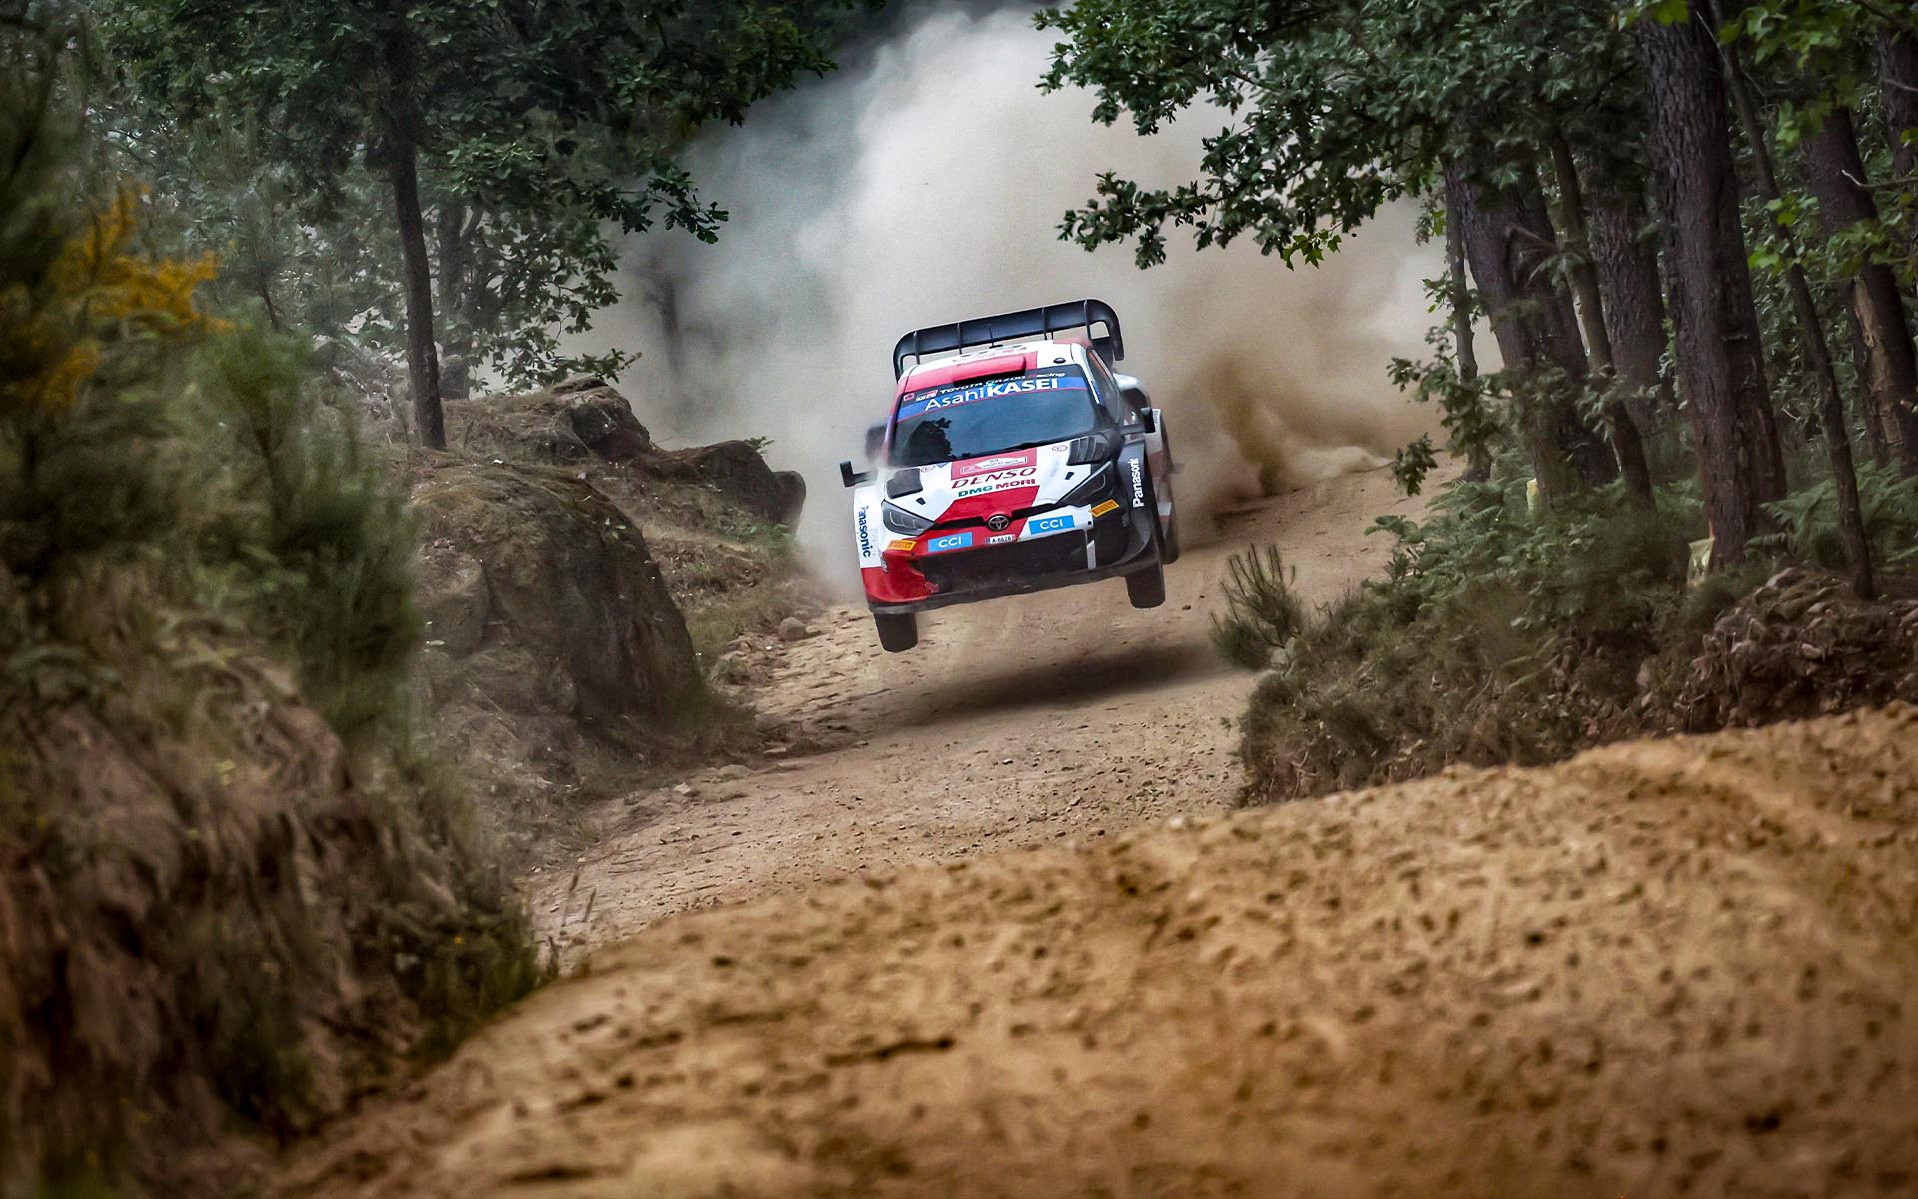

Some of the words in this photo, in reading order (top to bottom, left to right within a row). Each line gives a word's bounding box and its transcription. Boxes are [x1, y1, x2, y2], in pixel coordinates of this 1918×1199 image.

[940, 382, 983, 394] TOYOTA
[952, 468, 1037, 489] DENSO
[958, 485, 993, 497] DMG
[995, 479, 1036, 490] MORI
[1040, 518, 1064, 530] CCI
[938, 536, 962, 548] CCI
